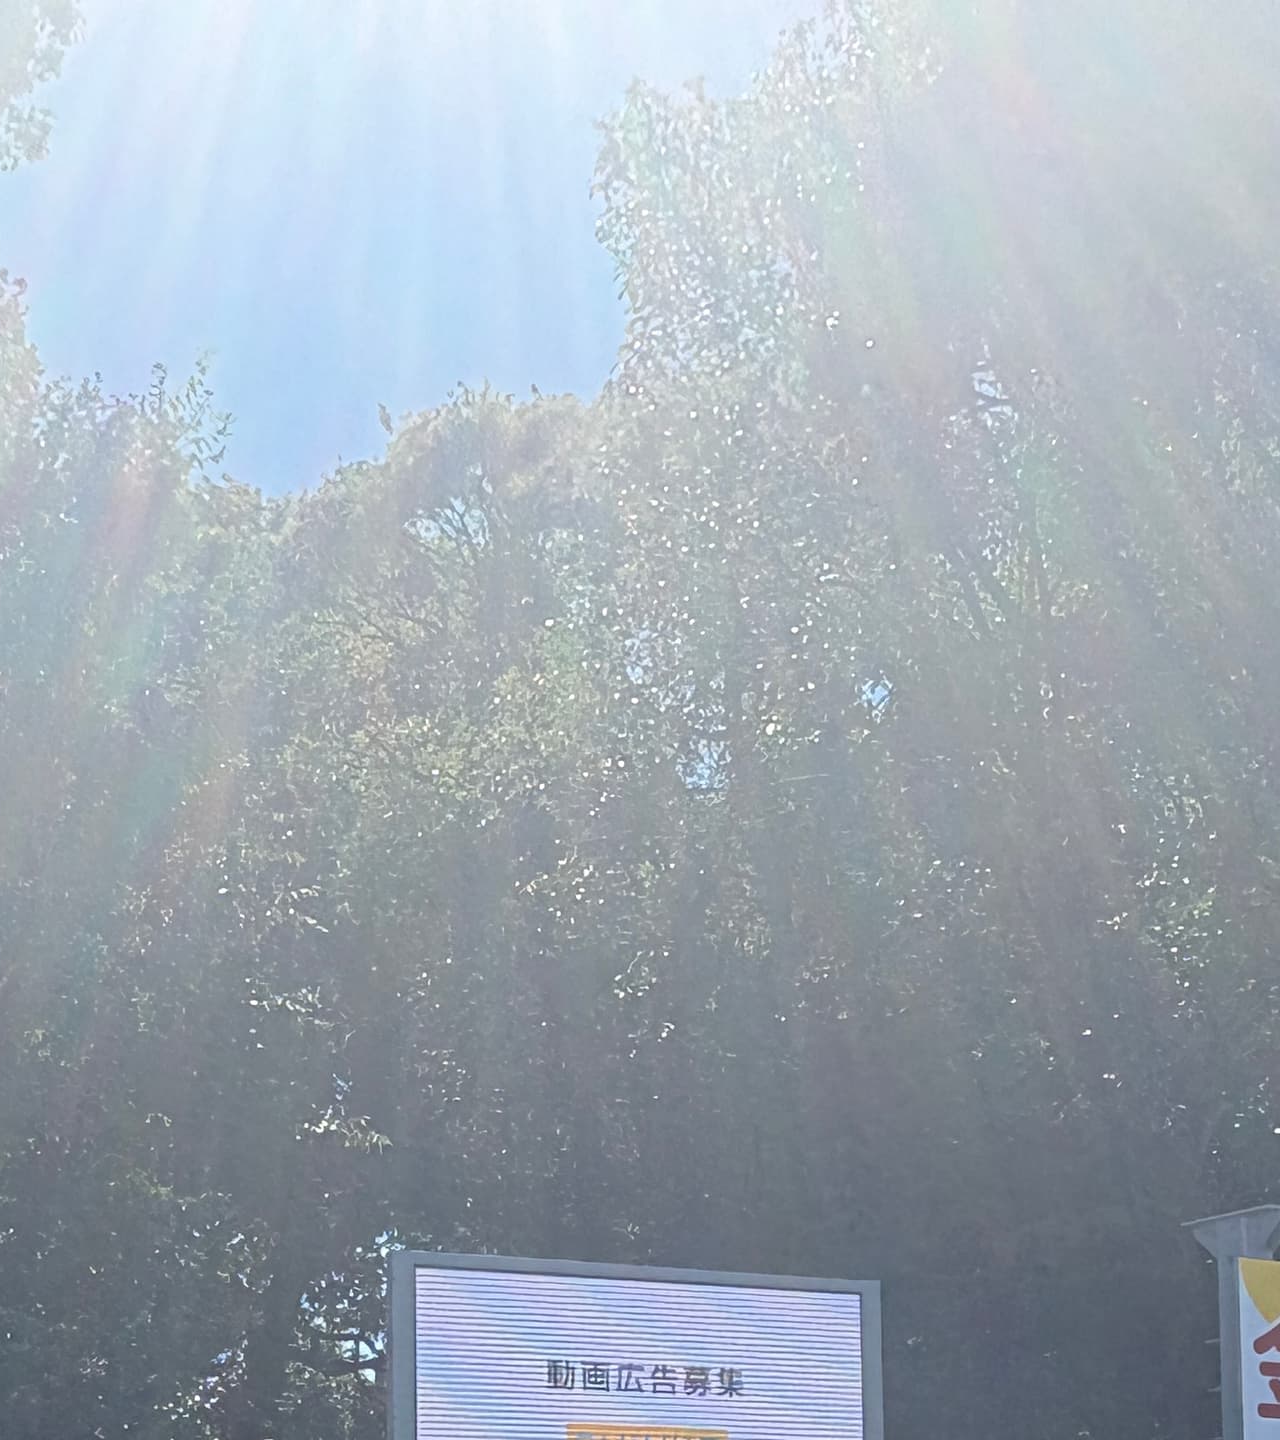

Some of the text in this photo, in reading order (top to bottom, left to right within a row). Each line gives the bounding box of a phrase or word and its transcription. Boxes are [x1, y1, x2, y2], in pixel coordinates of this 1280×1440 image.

[546, 1358, 744, 1398] 動画広告募集
